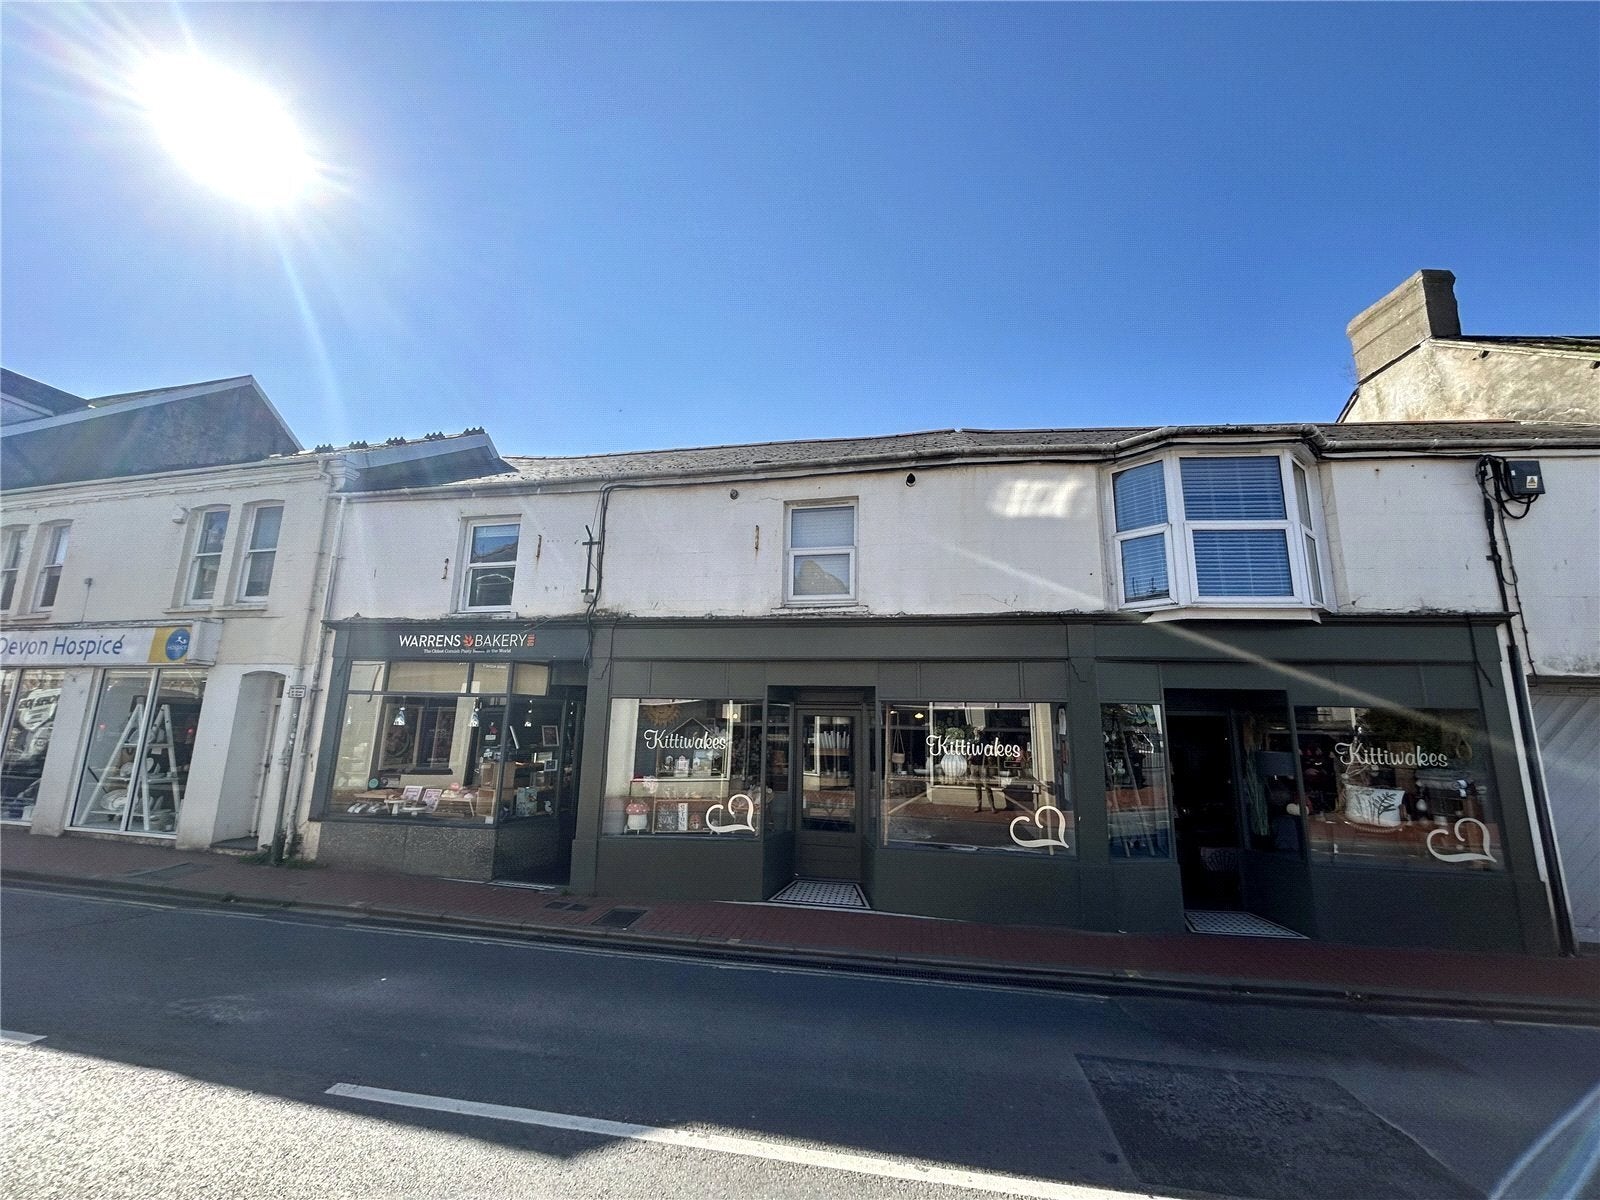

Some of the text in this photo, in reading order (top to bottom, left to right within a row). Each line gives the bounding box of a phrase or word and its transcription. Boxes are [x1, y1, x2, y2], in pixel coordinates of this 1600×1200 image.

[0, 637, 48, 655] Devon
[399, 634, 461, 647] WARRENS
[474, 634, 527, 647] BAKERY
[643, 729, 727, 750] Kittiwakes
[925, 734, 1021, 758] Kittiwakes
[1334, 742, 1449, 768] Kittiwakes
